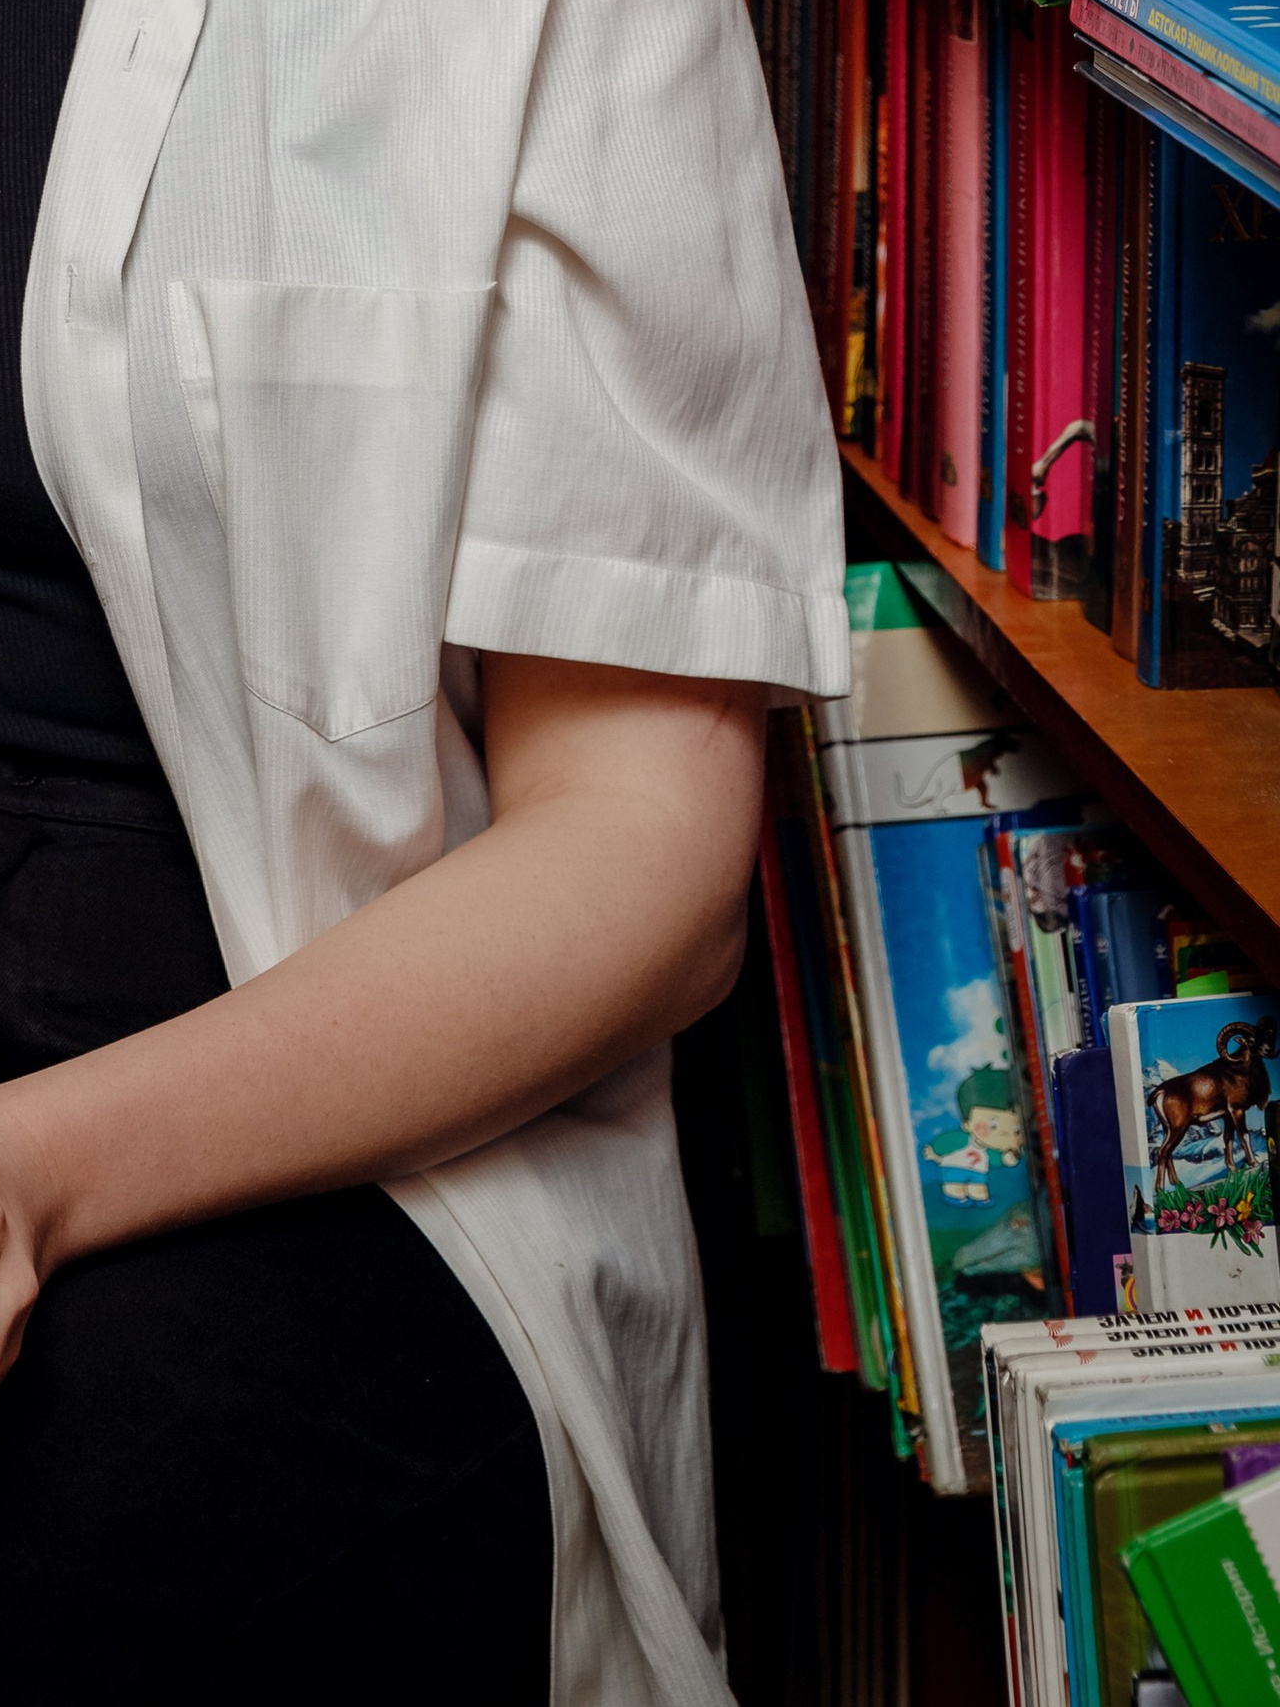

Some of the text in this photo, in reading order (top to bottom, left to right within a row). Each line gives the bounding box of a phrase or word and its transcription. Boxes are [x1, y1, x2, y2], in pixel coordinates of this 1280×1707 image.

[1147, 8, 1188, 48] ДЕТСКАЯ
[1187, 32, 1259, 93] ЭНЦИКЛОПЕДИЯ
[1014, 277, 1028, 394] ВЕЛИКИХ
[1014, 401, 1026, 454] СТО
[1118, 352, 1130, 463] ВЕЛИКИХ
[1117, 470, 1126, 522] СТО
[1098, 1309, 1180, 1329] ЗАЧЕМ
[1183, 1308, 1204, 1322] И
[1106, 1326, 1189, 1342] ЗАЧЕМ
[1194, 1325, 1213, 1336] И
[1131, 1342, 1214, 1358] ЗАЧЕМ
[1219, 1340, 1238, 1352] И
[1221, 1557, 1275, 1657] История
